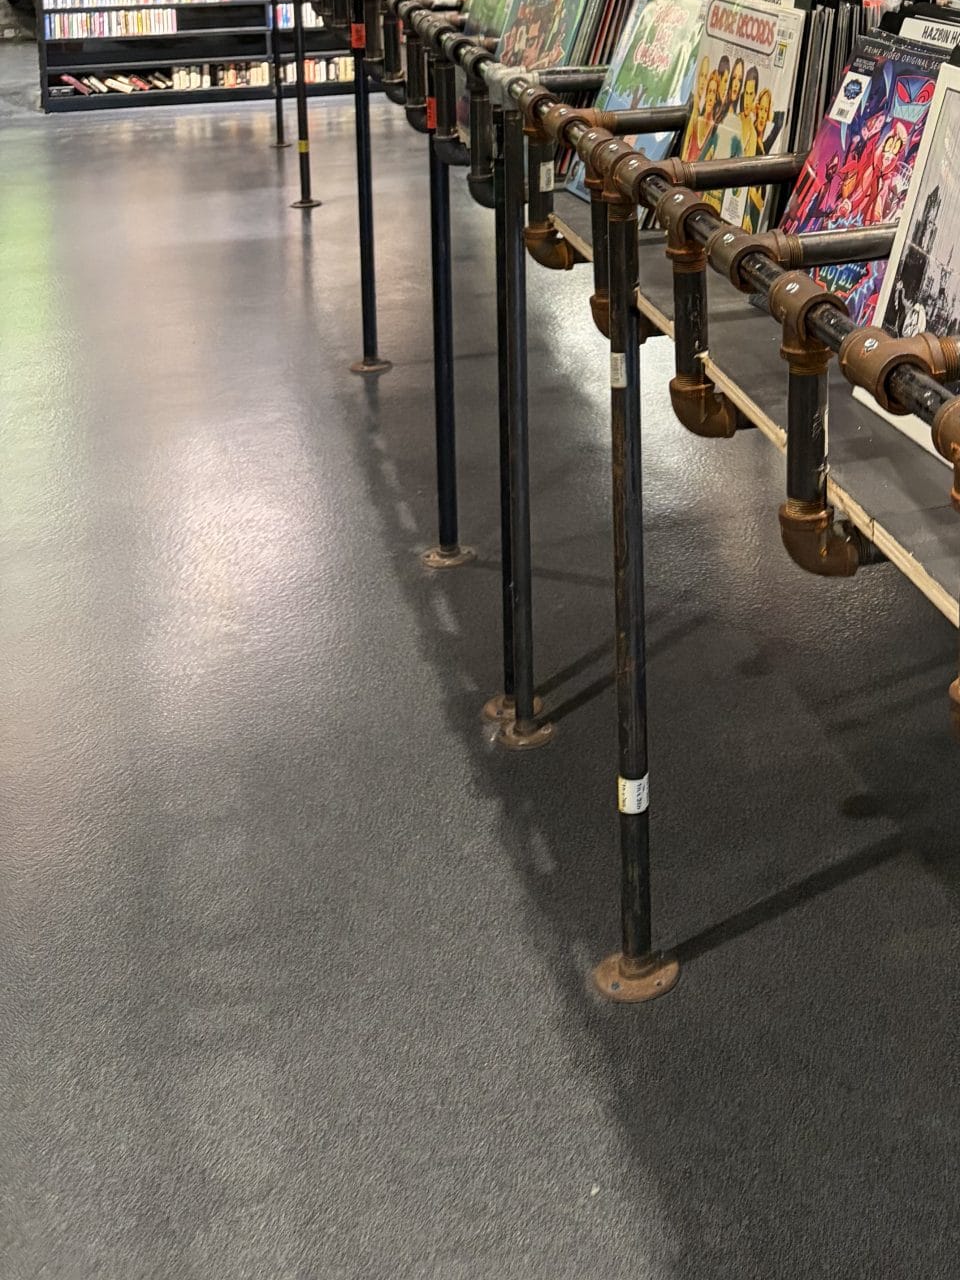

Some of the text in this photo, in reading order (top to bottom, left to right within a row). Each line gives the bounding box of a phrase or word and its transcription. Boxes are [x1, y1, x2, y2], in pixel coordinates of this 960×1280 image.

[735, 11, 777, 47] RECORDS
[921, 25, 951, 48] HAZBIN
[863, 45, 882, 57] PRIME
[883, 50, 900, 61] VIDEO
[902, 54, 929, 68] ORIGINAL
[819, 266, 853, 291] HOTEL
